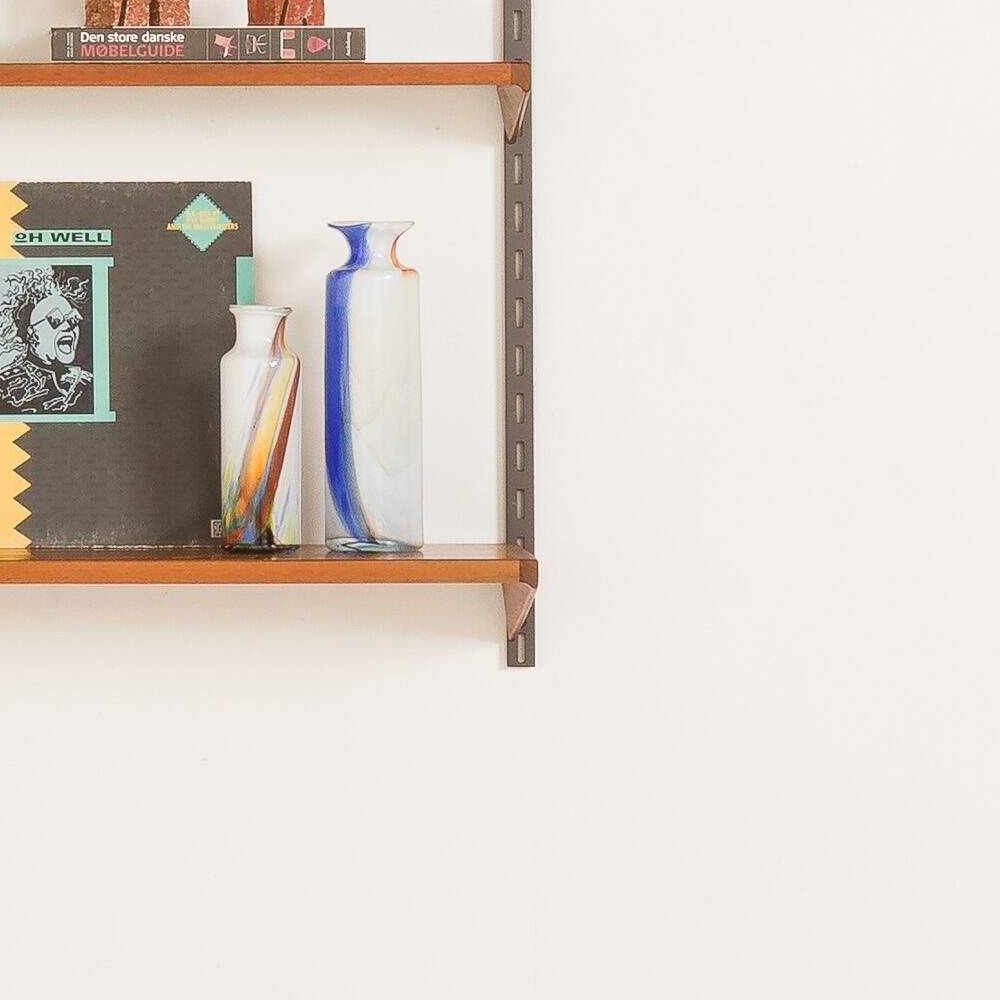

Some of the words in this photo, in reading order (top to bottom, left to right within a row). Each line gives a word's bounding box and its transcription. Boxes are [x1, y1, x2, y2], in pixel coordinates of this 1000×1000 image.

[80, 31, 105, 43] Den
[107, 31, 139, 43] store
[141, 31, 185, 43] danske
[81, 44, 185, 57] MØBELGUIDE
[51, 231, 109, 243] WELL
